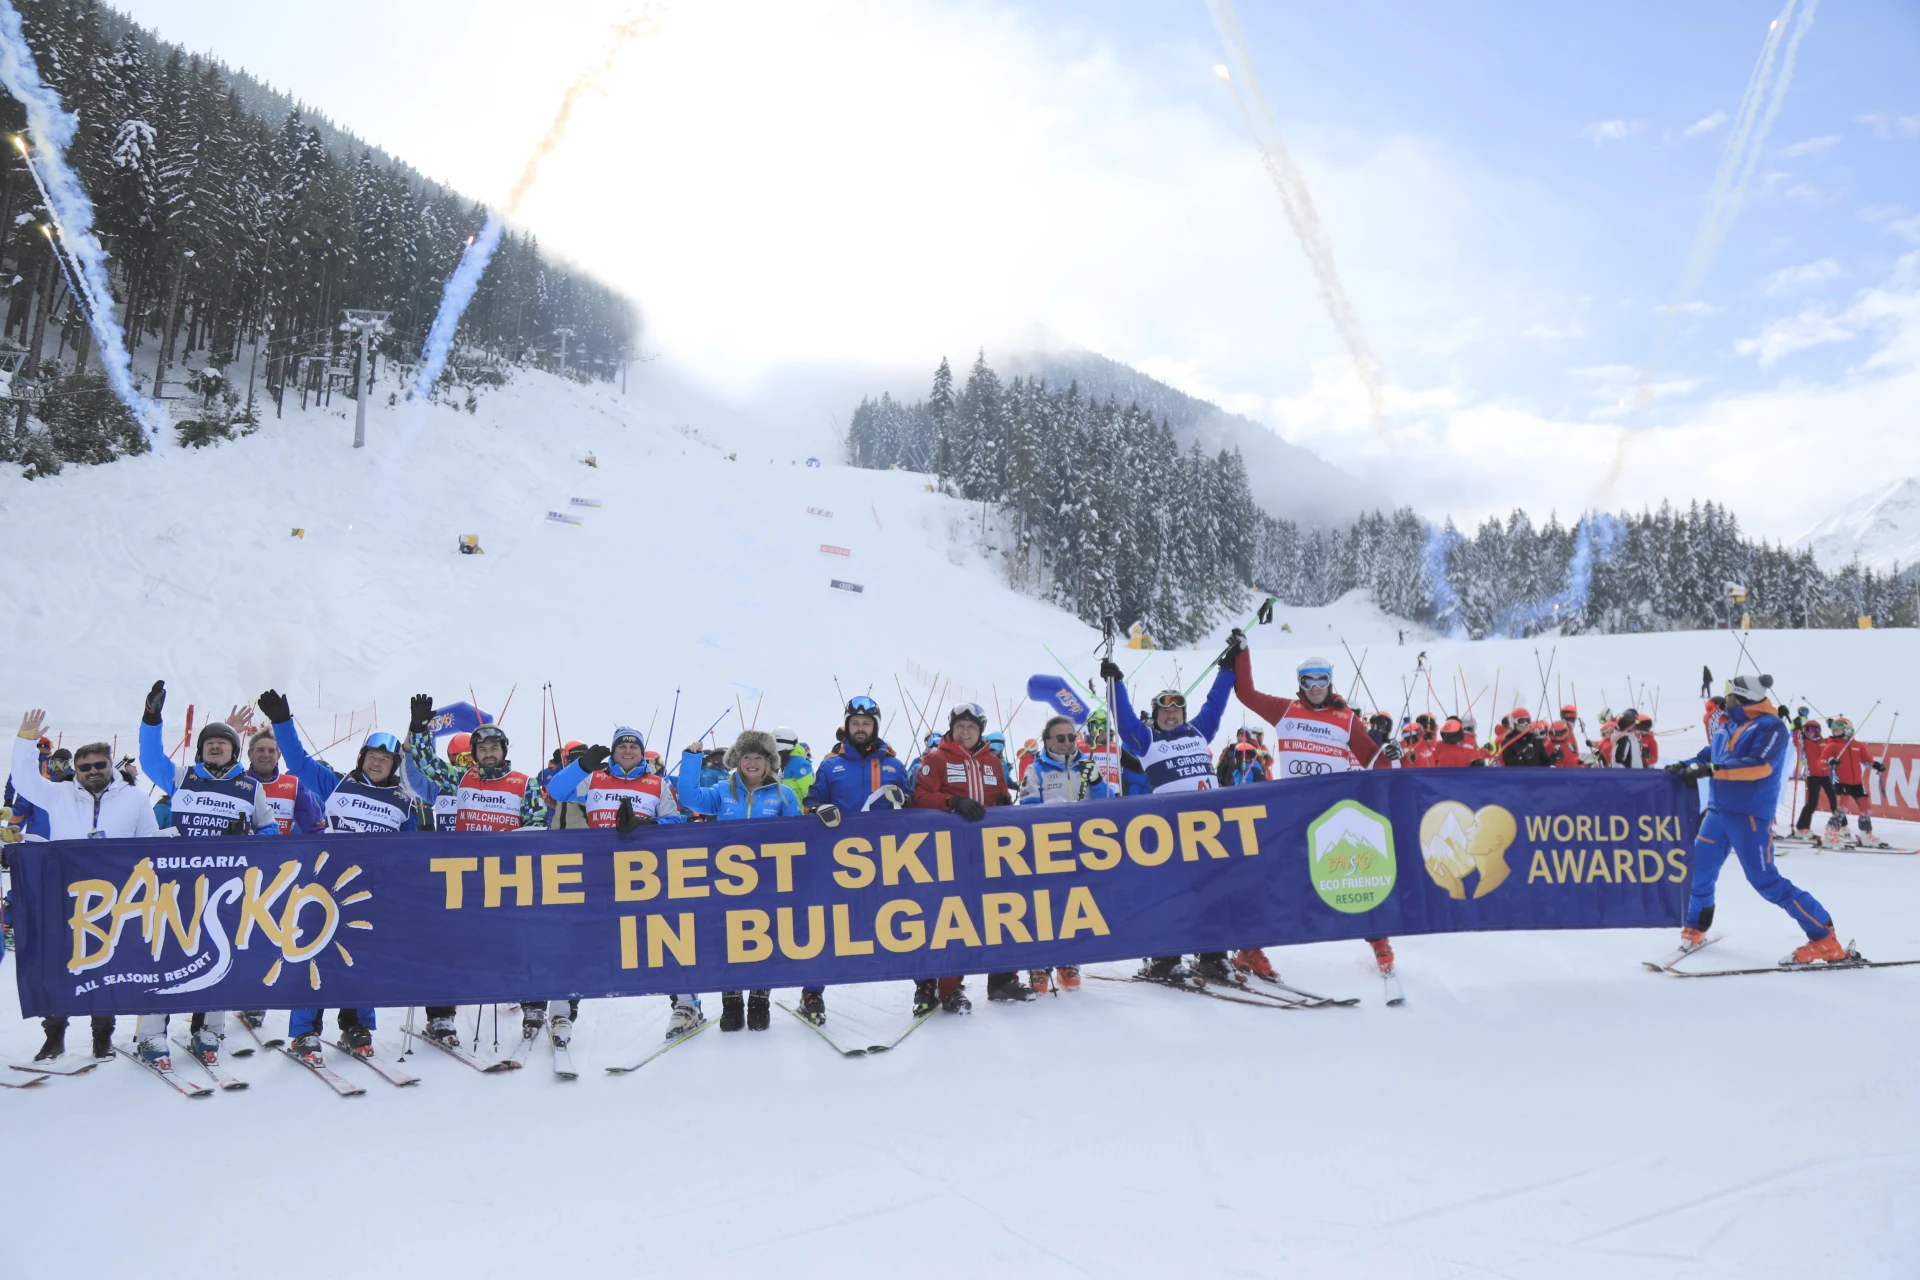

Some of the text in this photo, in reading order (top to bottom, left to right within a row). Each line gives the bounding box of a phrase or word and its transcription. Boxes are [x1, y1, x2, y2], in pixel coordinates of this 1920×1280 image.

[1296, 723, 1331, 735] Fibank
[1292, 742, 1342, 756] WALCHHOFER
[1177, 766, 1207, 777] TEAM
[196, 796, 236, 810] Fibank
[472, 793, 505, 804] Fibank
[352, 798, 391, 816] Fibank
[182, 815, 229, 828] M. GIRARD
[467, 811, 519, 826] WALCHHOFER
[187, 828, 221, 836] TEAM
[465, 823, 492, 831] TEAM
[1525, 815, 1682, 842] WORLD SKI
[157, 856, 249, 869] BULGARIA
[431, 806, 1266, 908] THE BEST SKI RESORT
[1328, 853, 1373, 876] BANSKO
[1528, 848, 1688, 884] AWARDS
[1320, 875, 1391, 891] ECO FRIENDLY
[1335, 892, 1375, 904] RESORT
[66, 857, 340, 995] BANSKO
[620, 887, 1111, 968] IN BULGARIA
[75, 951, 212, 996] ALL SEASONS RESORT
